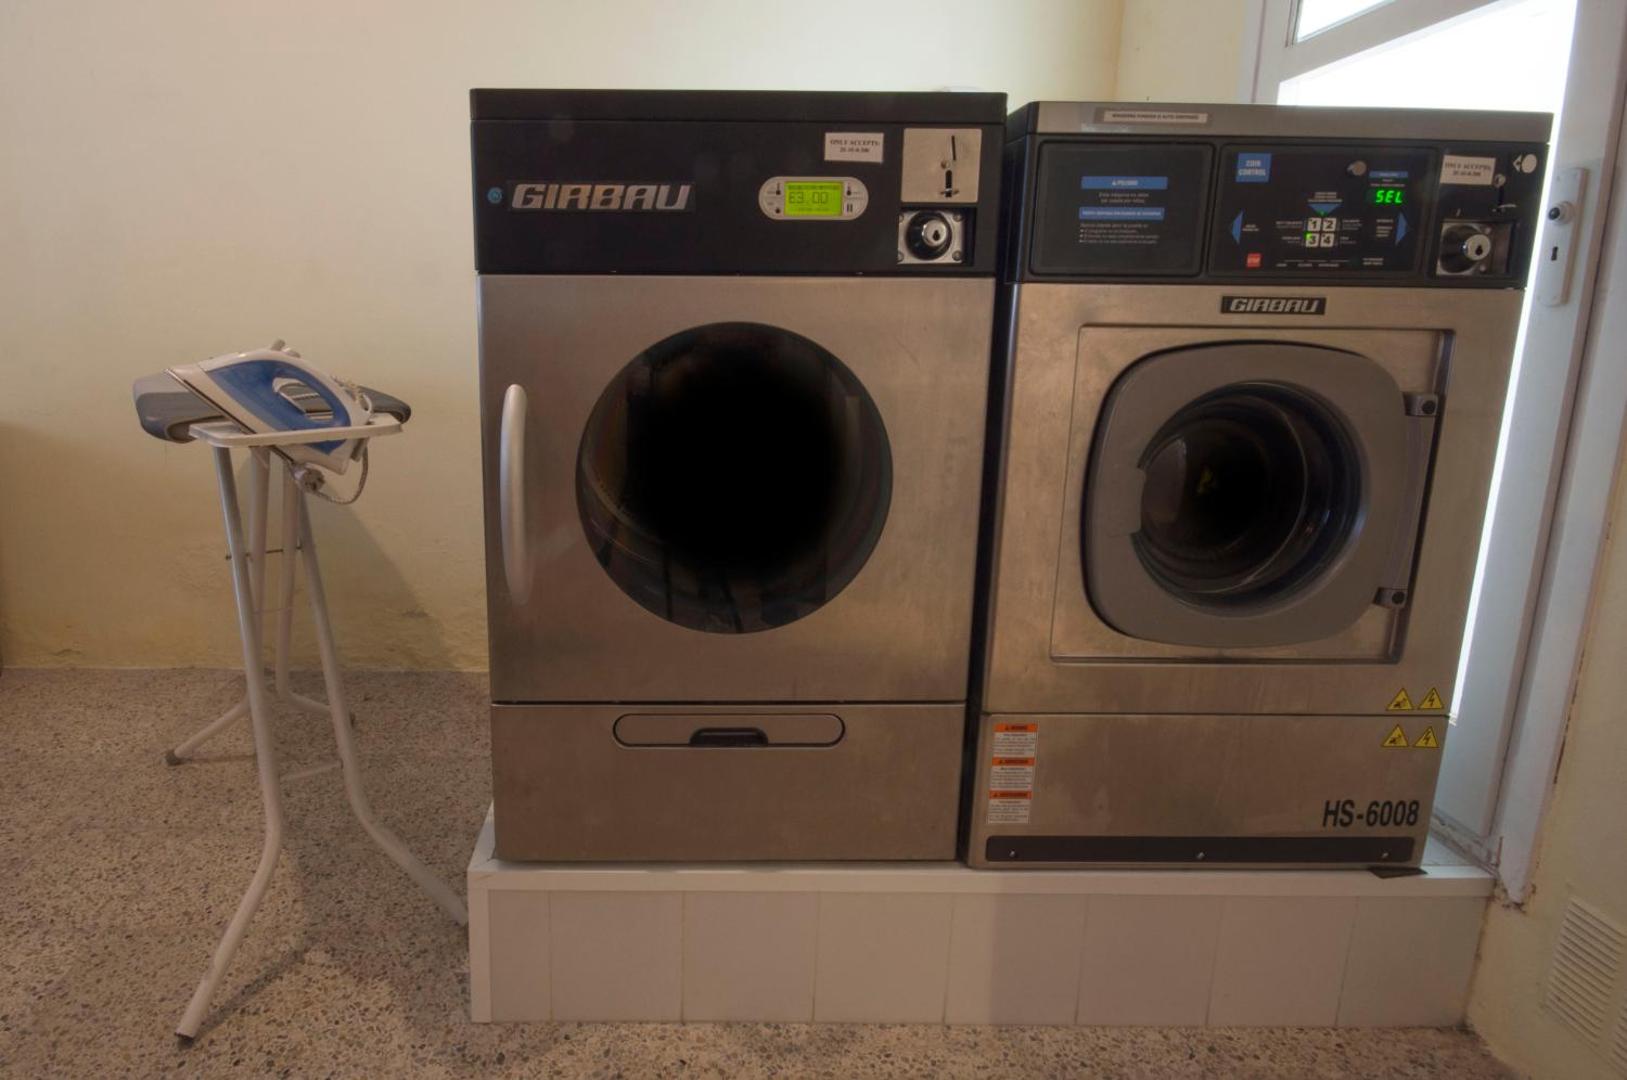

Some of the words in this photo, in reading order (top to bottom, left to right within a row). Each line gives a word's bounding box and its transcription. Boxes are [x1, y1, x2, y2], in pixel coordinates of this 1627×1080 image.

[511, 183, 691, 211] GIRBAU
[1375, 190, 1404, 204] SEL
[1230, 298, 1320, 314] GIRBAU
[1322, 799, 1420, 828] HS-6008
